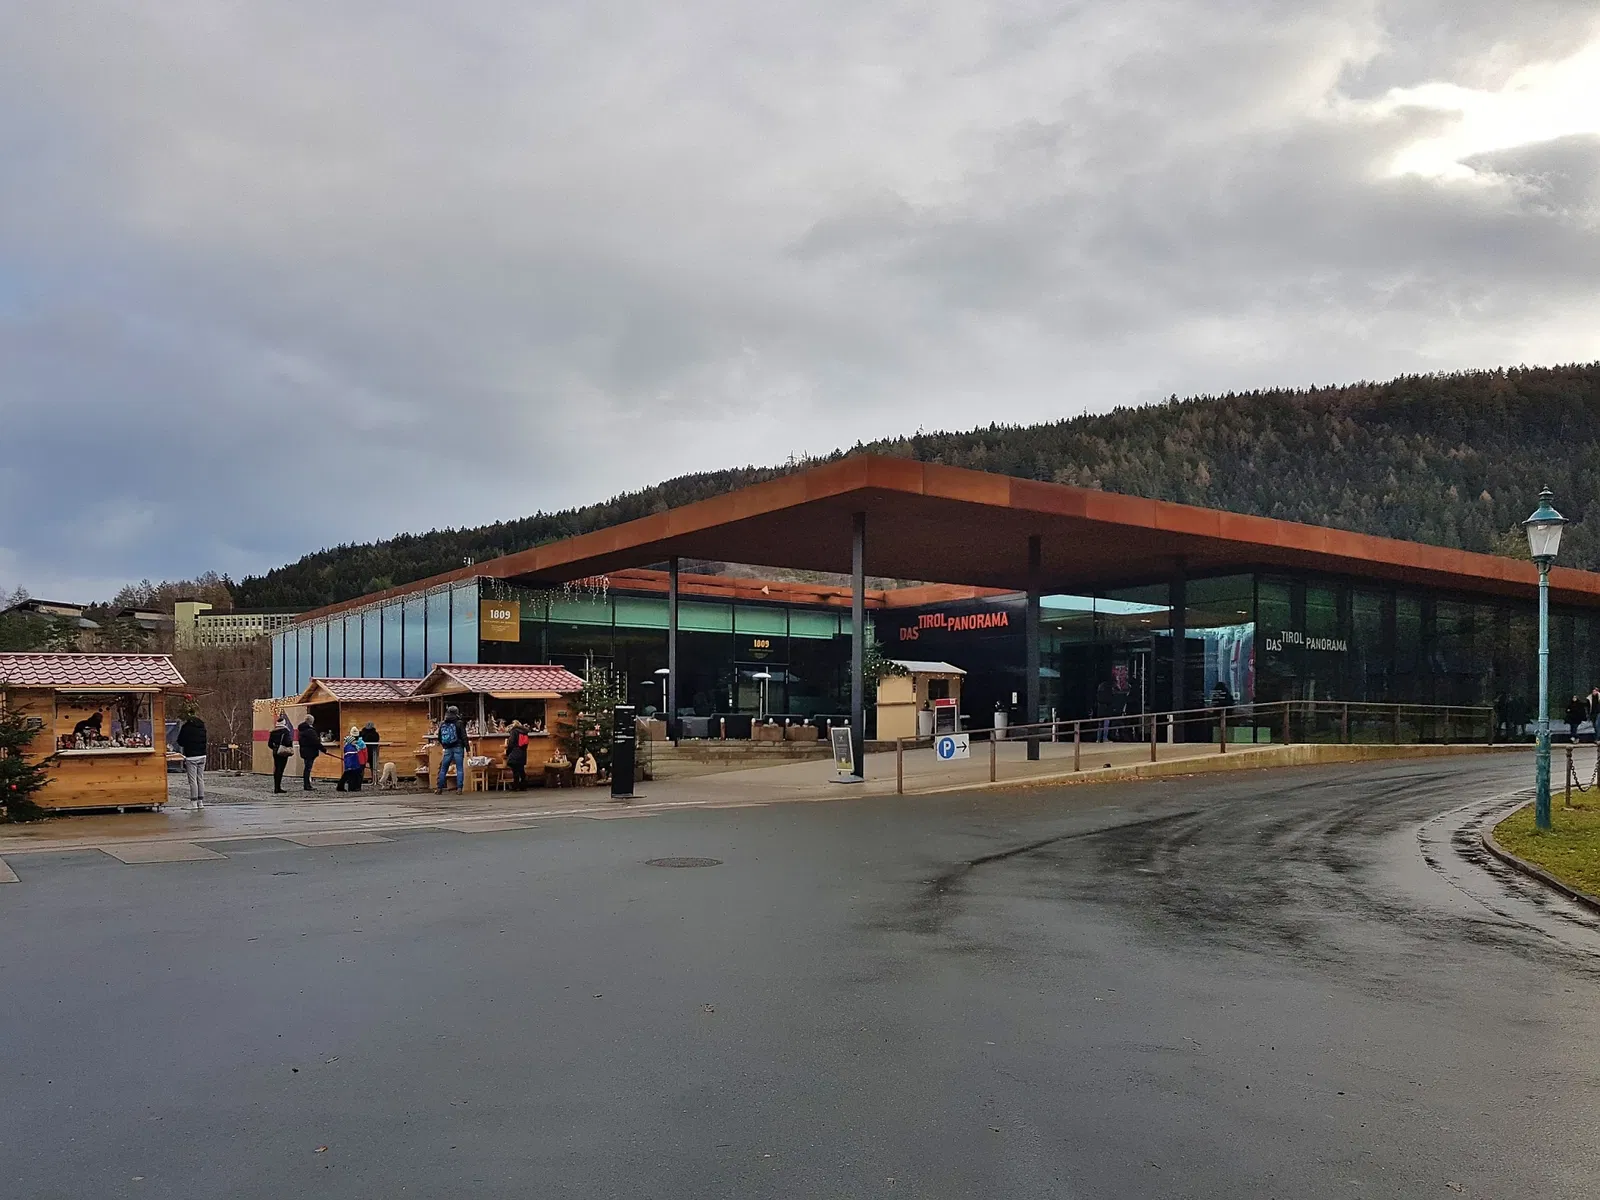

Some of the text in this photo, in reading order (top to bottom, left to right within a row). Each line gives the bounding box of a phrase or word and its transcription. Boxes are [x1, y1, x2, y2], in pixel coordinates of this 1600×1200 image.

[490, 609, 511, 620] 1809
[900, 611, 1009, 641] DAS TIROL PANORAMA
[753, 639, 770, 648] 1809
[1266, 630, 1348, 652] DAS TIROL PANORAMA
